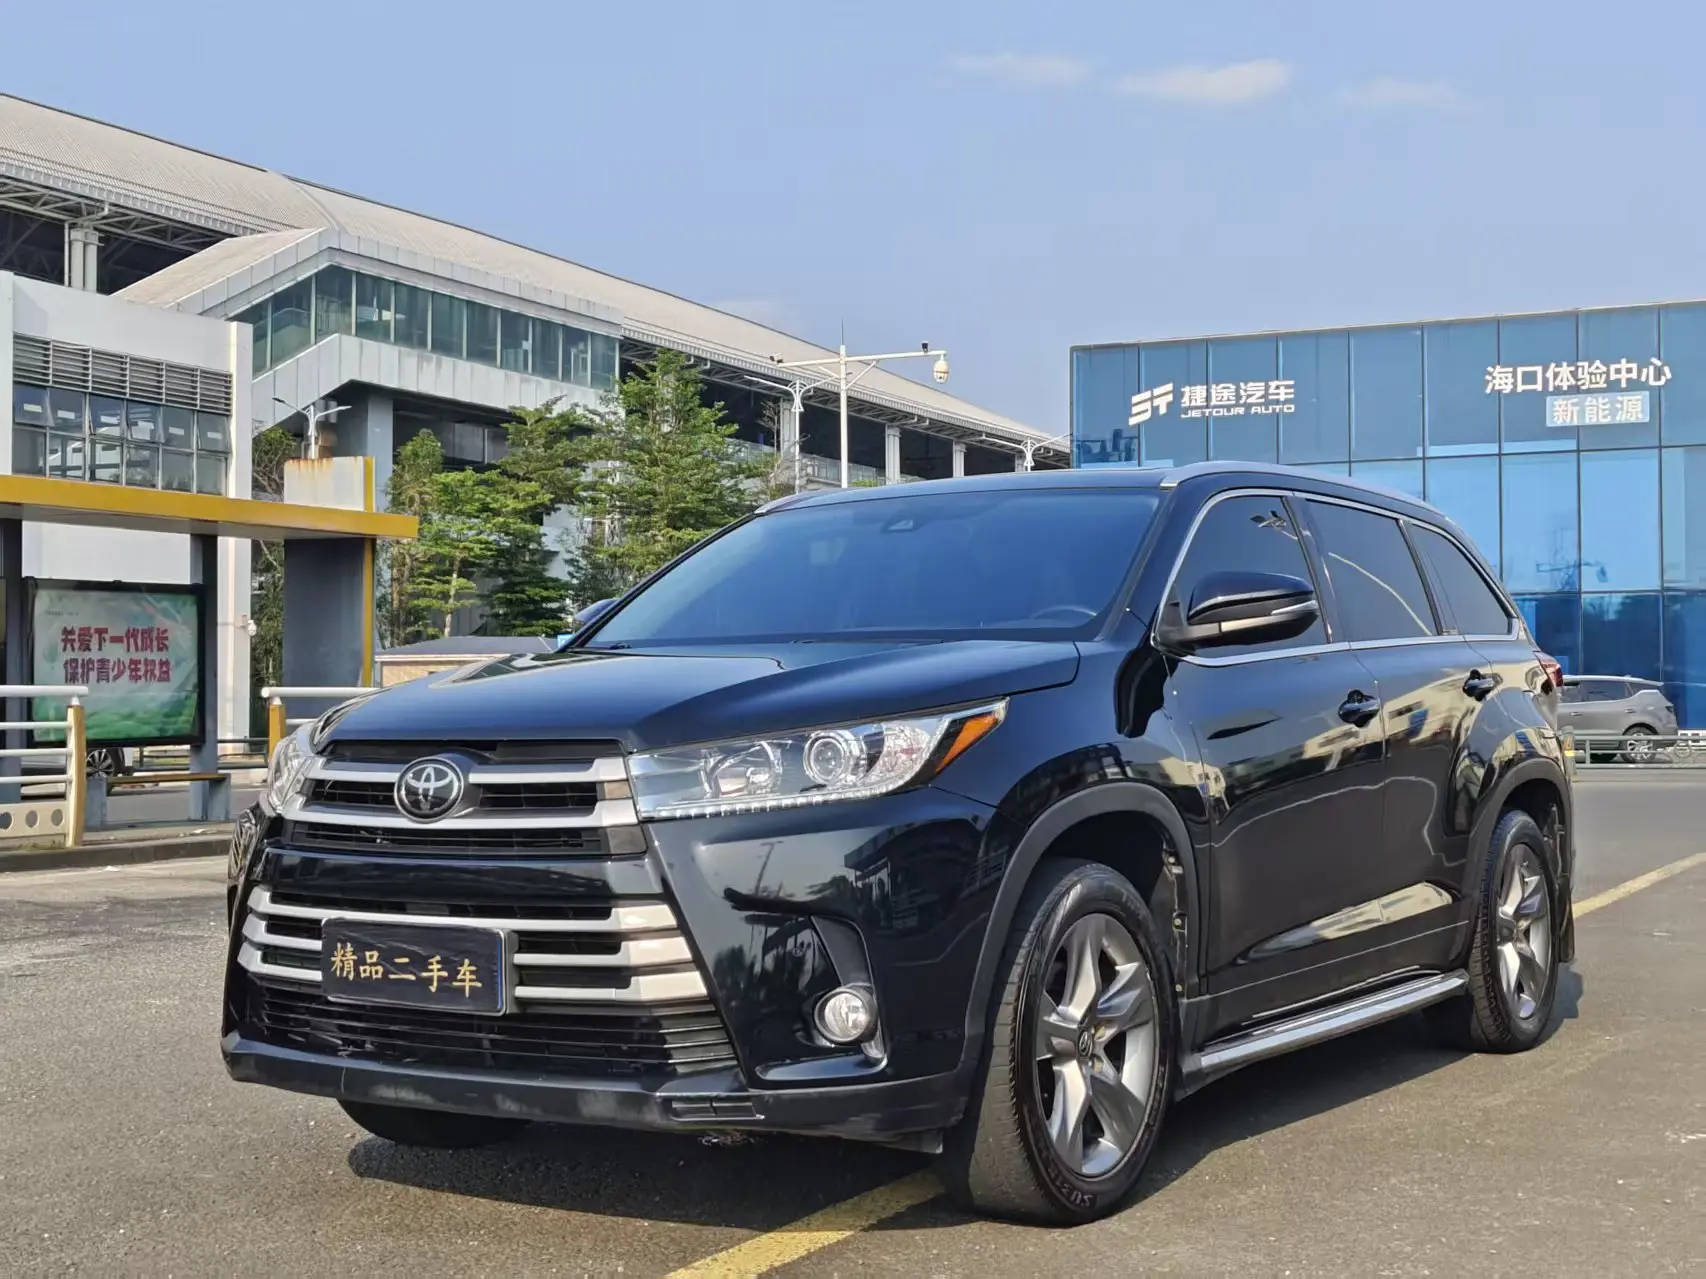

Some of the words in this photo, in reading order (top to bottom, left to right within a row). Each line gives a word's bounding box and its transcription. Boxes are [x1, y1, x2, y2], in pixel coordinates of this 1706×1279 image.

[1484, 357, 1672, 394] 海口体验中心
[1181, 380, 1295, 407] 捷途汽车
[1181, 407, 1244, 418] JETOUR
[1251, 404, 1295, 414] AUTO
[1553, 395, 1642, 424] 新能源
[63, 658, 171, 684] 保护青少年权益
[330, 942, 482, 998] 精品二手车
